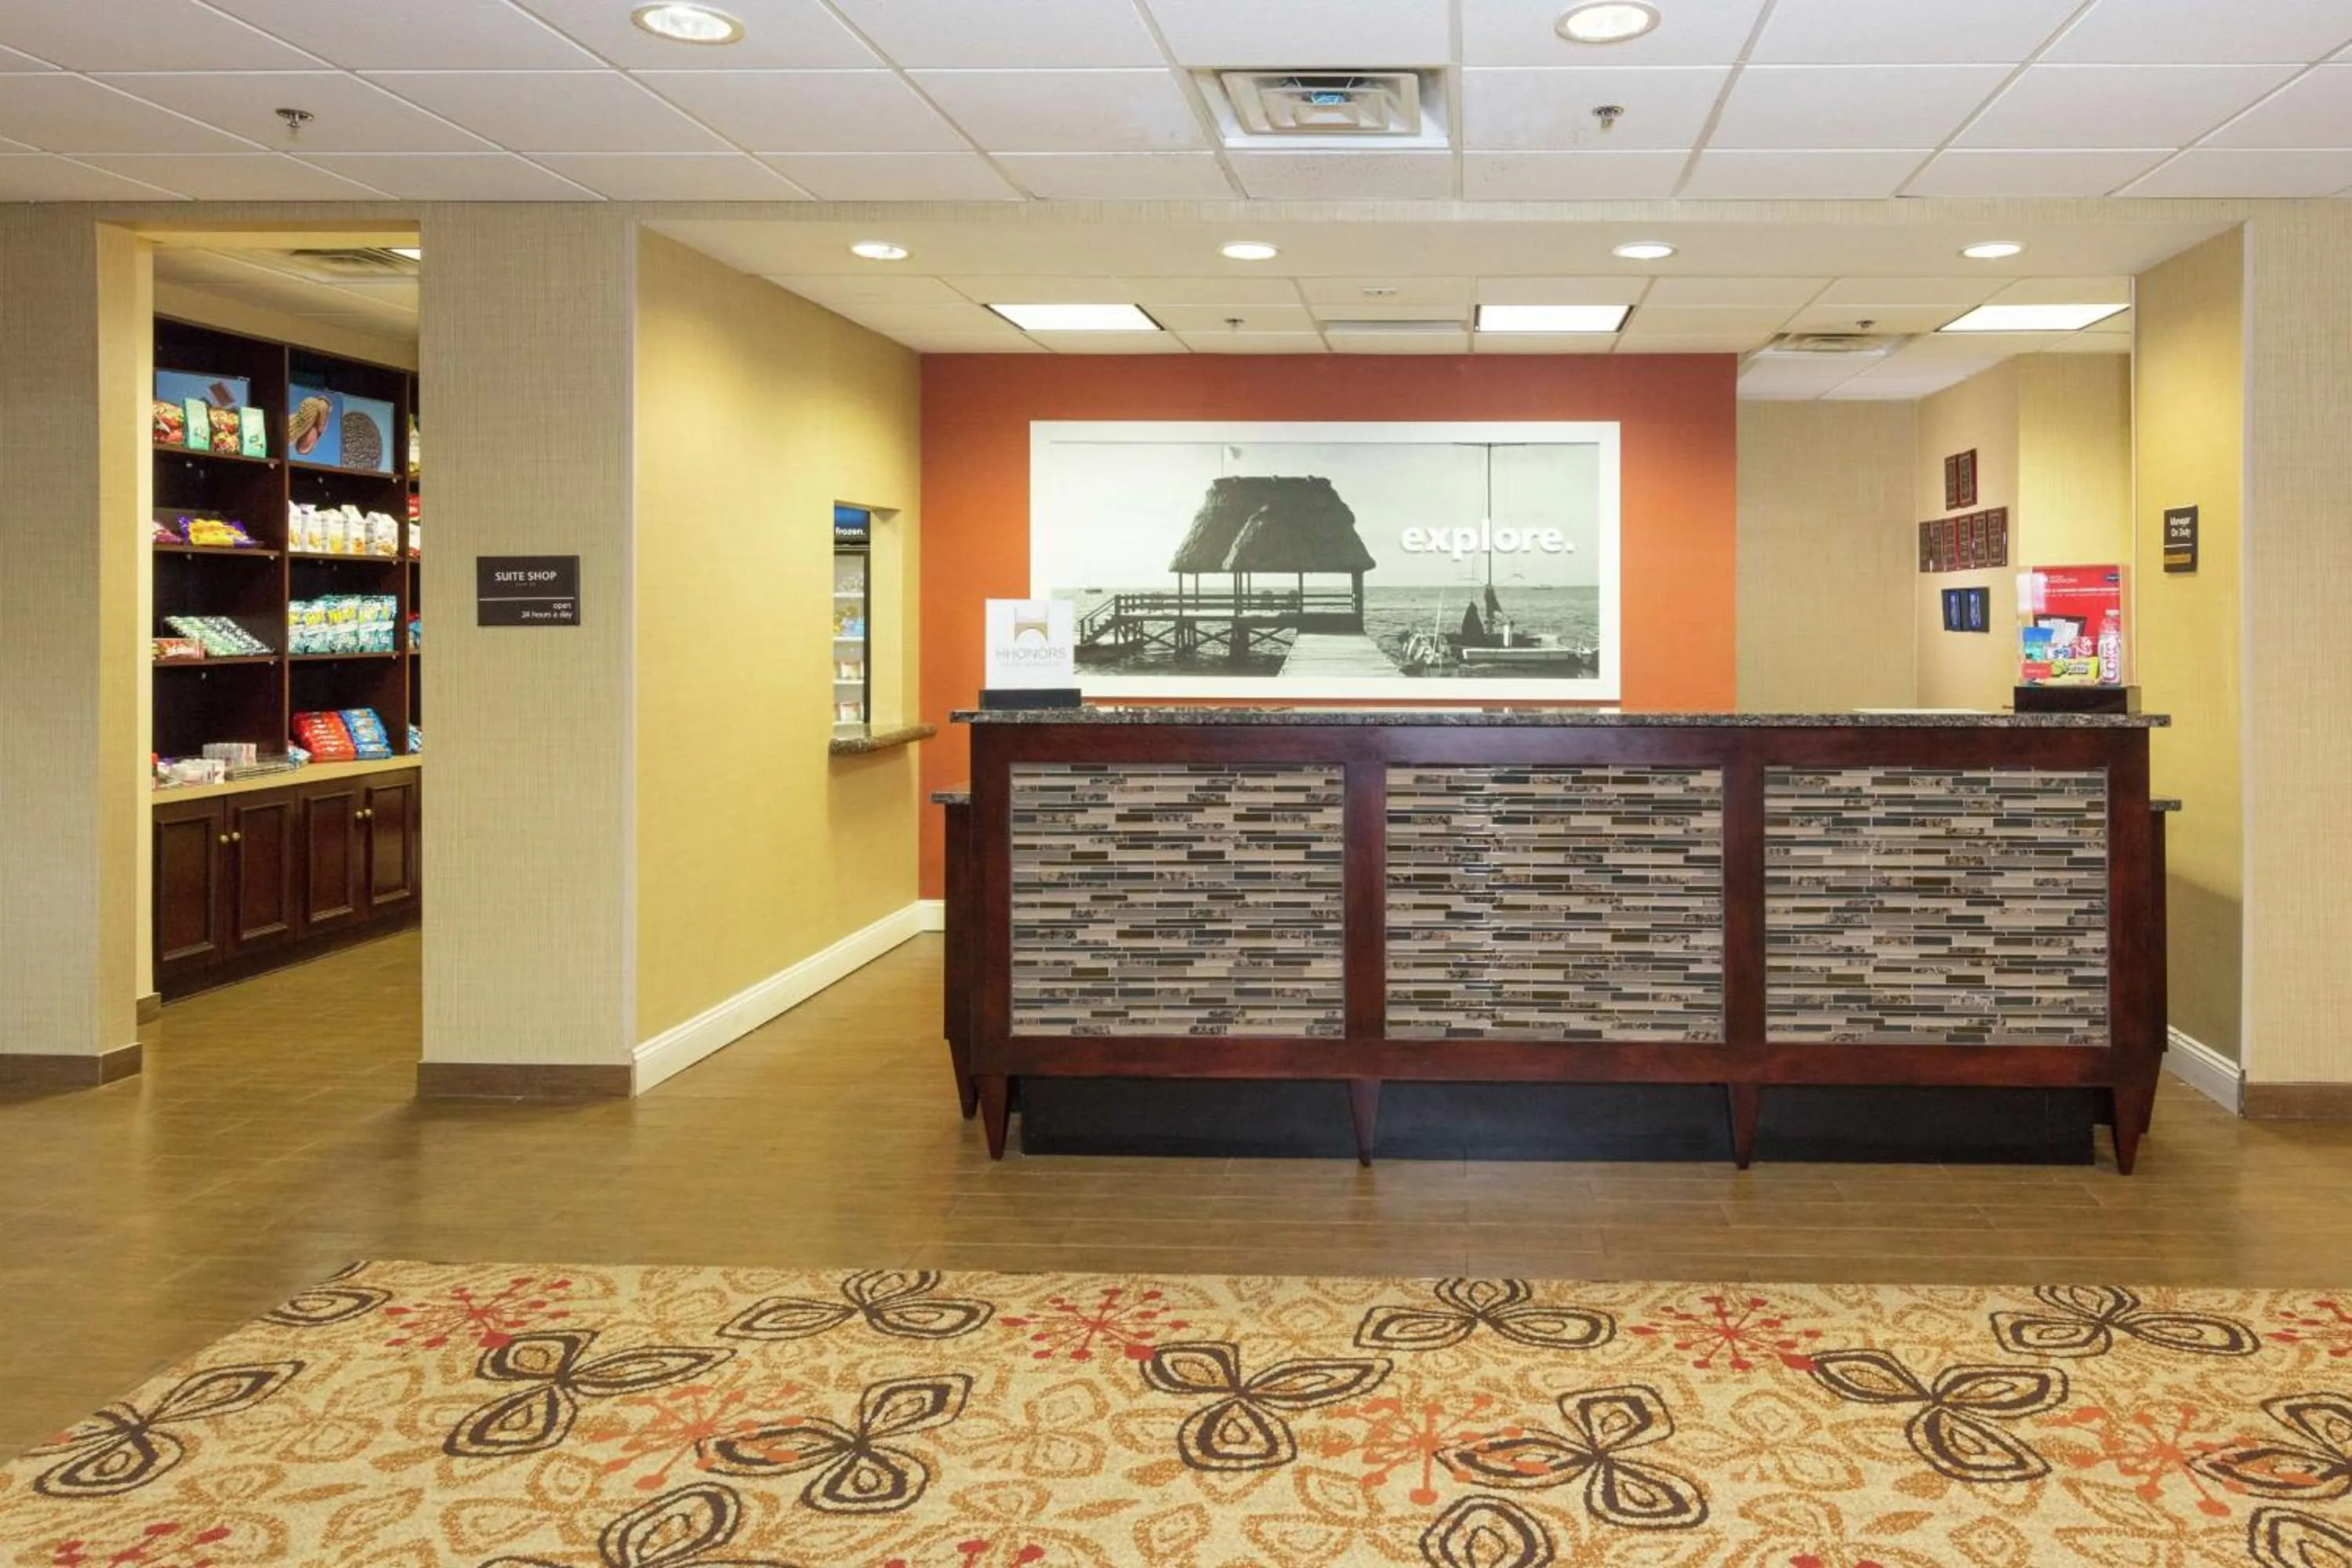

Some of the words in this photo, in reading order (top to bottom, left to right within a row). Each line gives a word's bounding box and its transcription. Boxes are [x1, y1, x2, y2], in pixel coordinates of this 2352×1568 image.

[835, 526, 866, 535] frozen.
[1399, 518, 1575, 561] explore.
[495, 571, 525, 581] SUITE
[528, 571, 557, 581] SHOP
[531, 610, 552, 619] hours
[559, 611, 573, 619] day
